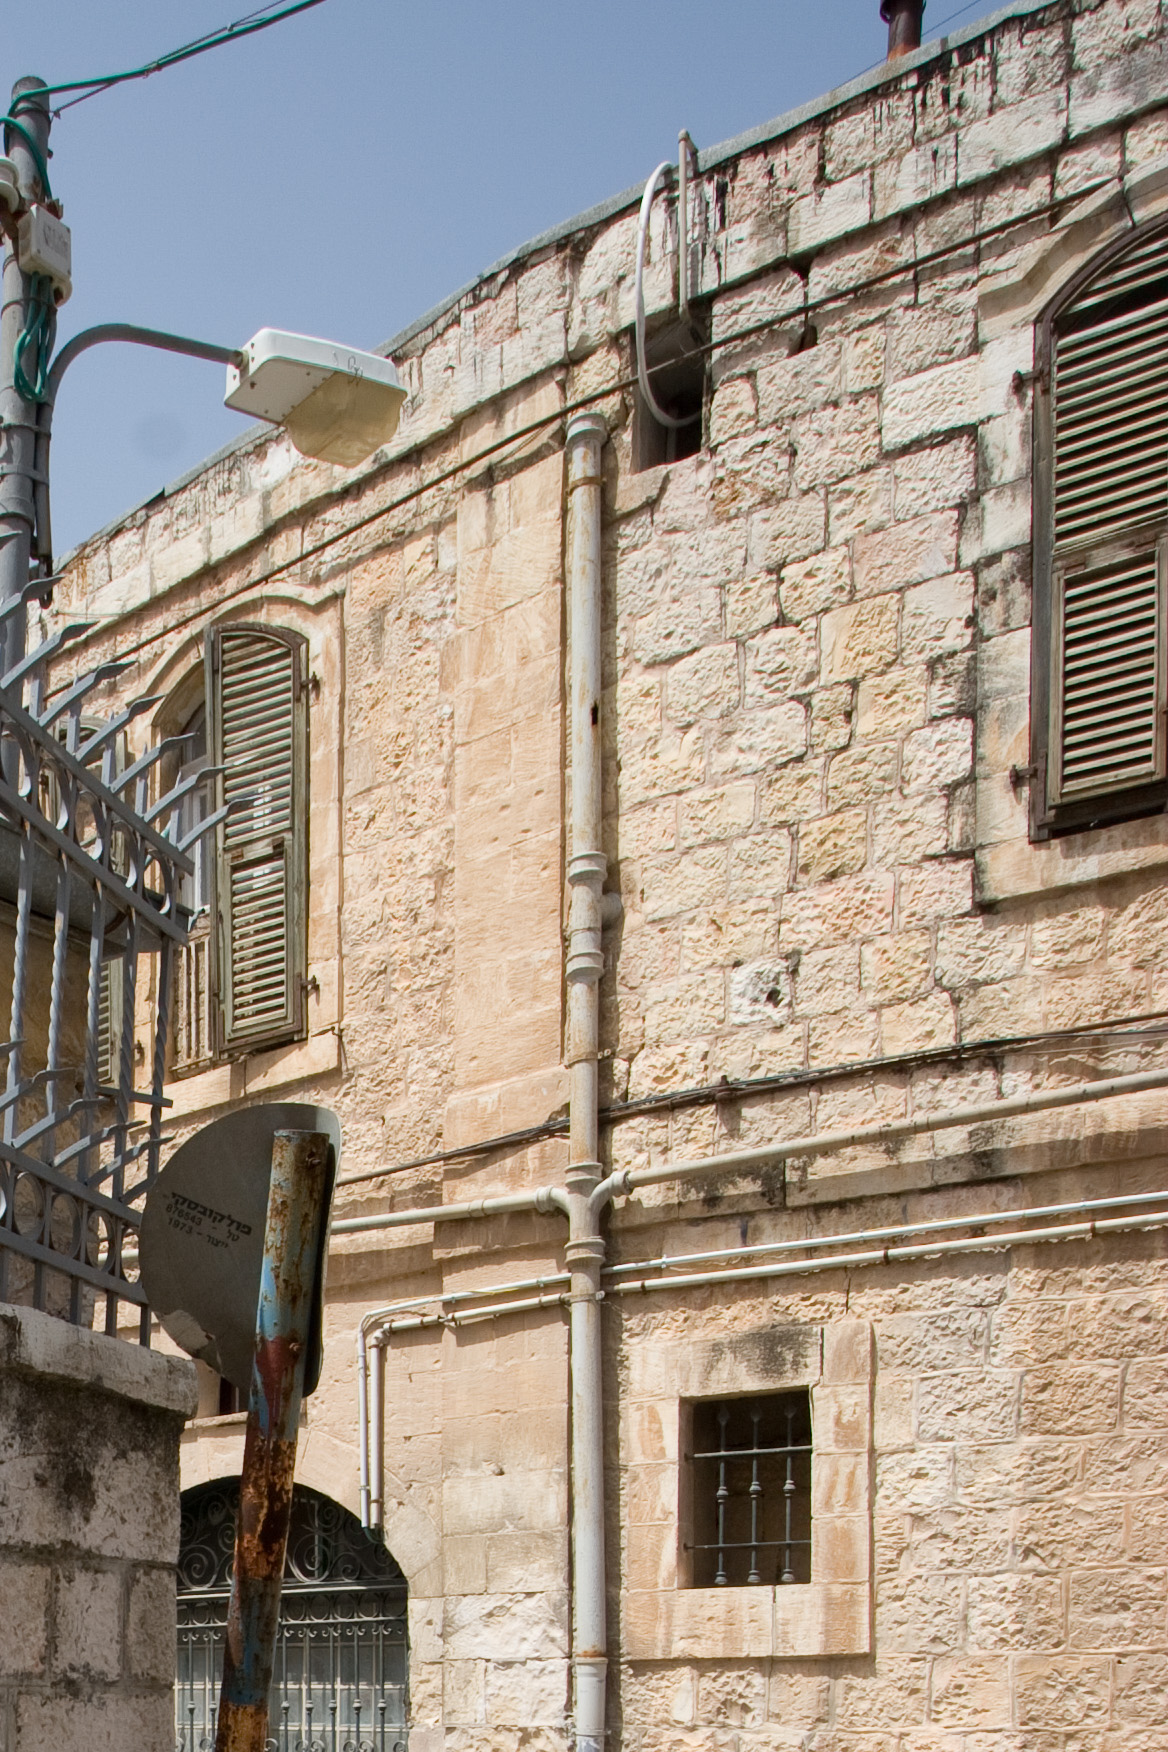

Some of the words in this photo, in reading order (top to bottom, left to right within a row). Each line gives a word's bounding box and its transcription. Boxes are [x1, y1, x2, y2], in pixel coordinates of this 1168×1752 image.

[166, 1204, 202, 1226] 876543
[171, 1192, 252, 1236] פולקובסקי
[167, 1217, 193, 1235] 1973
[206, 1235, 229, 1248] ייצור
[226, 1229, 240, 1242] טל
